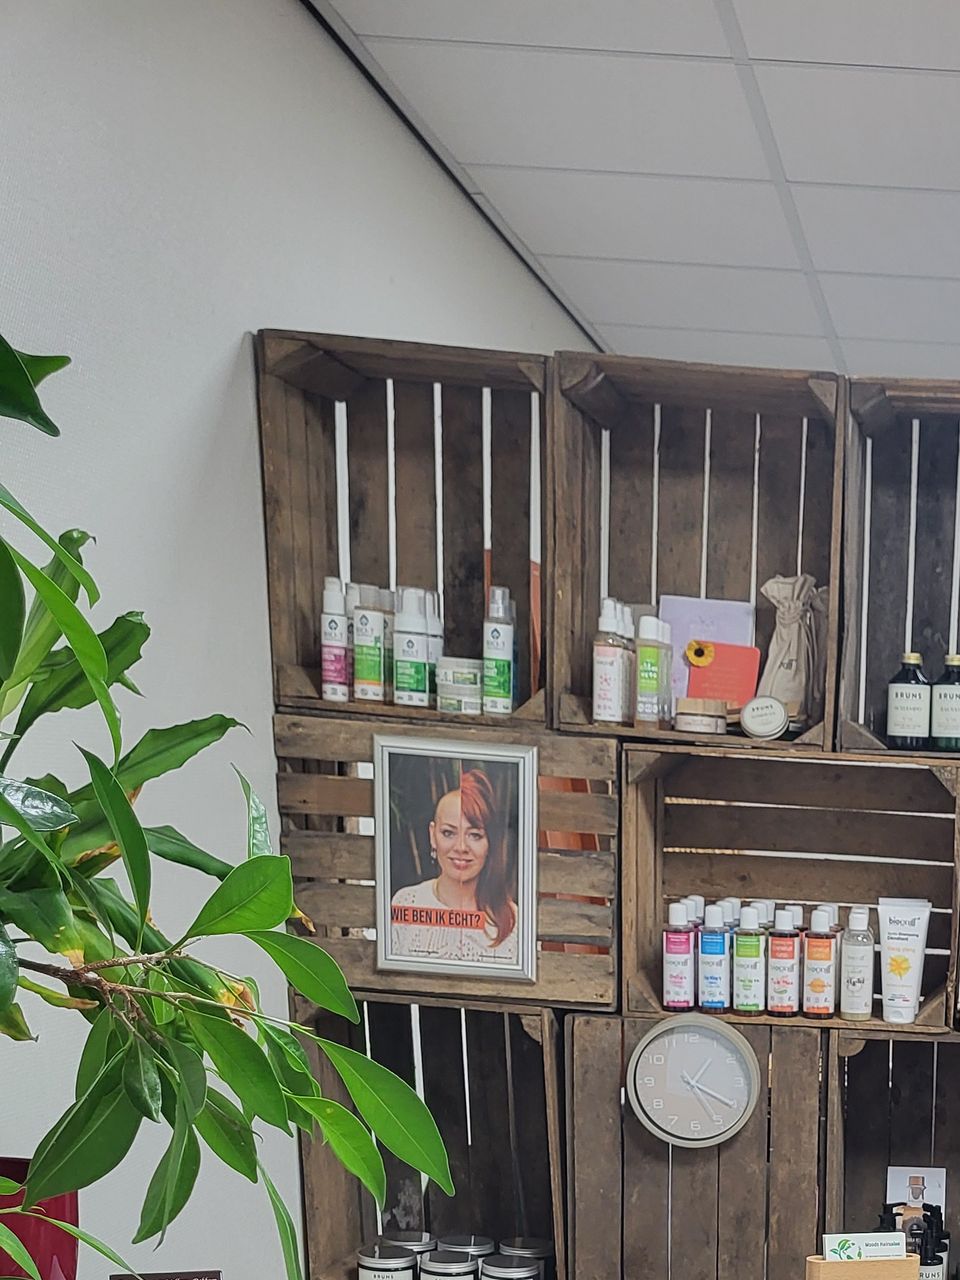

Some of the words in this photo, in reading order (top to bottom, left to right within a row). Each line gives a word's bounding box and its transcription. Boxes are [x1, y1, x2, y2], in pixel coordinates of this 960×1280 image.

[895, 691, 922, 700] BRUNS
[391, 908, 409, 922] WIE
[412, 909, 432, 923] BEN
[435, 911, 445, 925] IK
[448, 909, 481, 927] ÉCHT?
[684, 1033, 700, 1043] 12
[649, 1054, 665, 1065] 10
[643, 1076, 655, 1087] 9
[653, 1099, 664, 1109] 8
[668, 1115, 679, 1126] 7
[712, 1114, 723, 1125] 5
[690, 1120, 701, 1131] 6
[919, 1270, 941, 1279] RUNS
